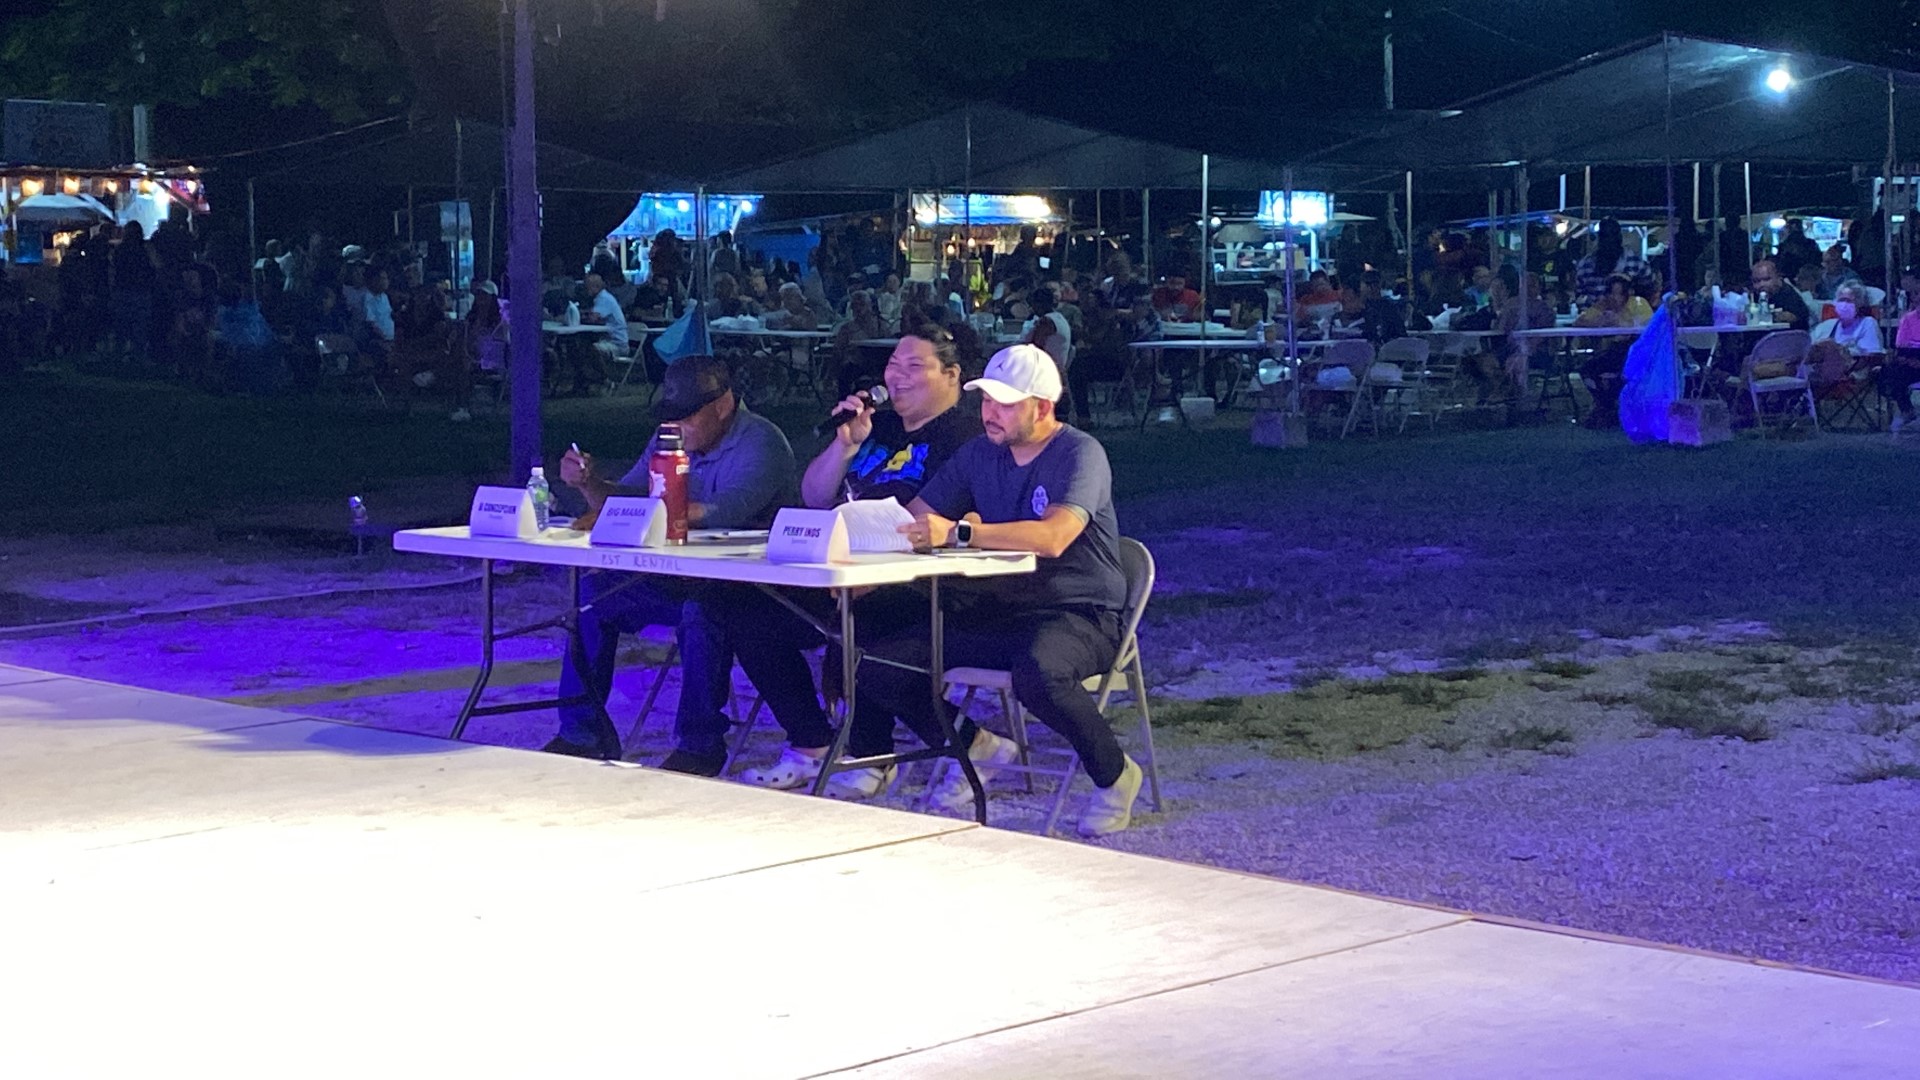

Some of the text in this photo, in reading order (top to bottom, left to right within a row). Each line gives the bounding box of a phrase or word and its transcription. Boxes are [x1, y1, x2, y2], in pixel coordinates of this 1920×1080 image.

[606, 507, 646, 517] BIG MAMA
[633, 555, 682, 571] RENTAL
